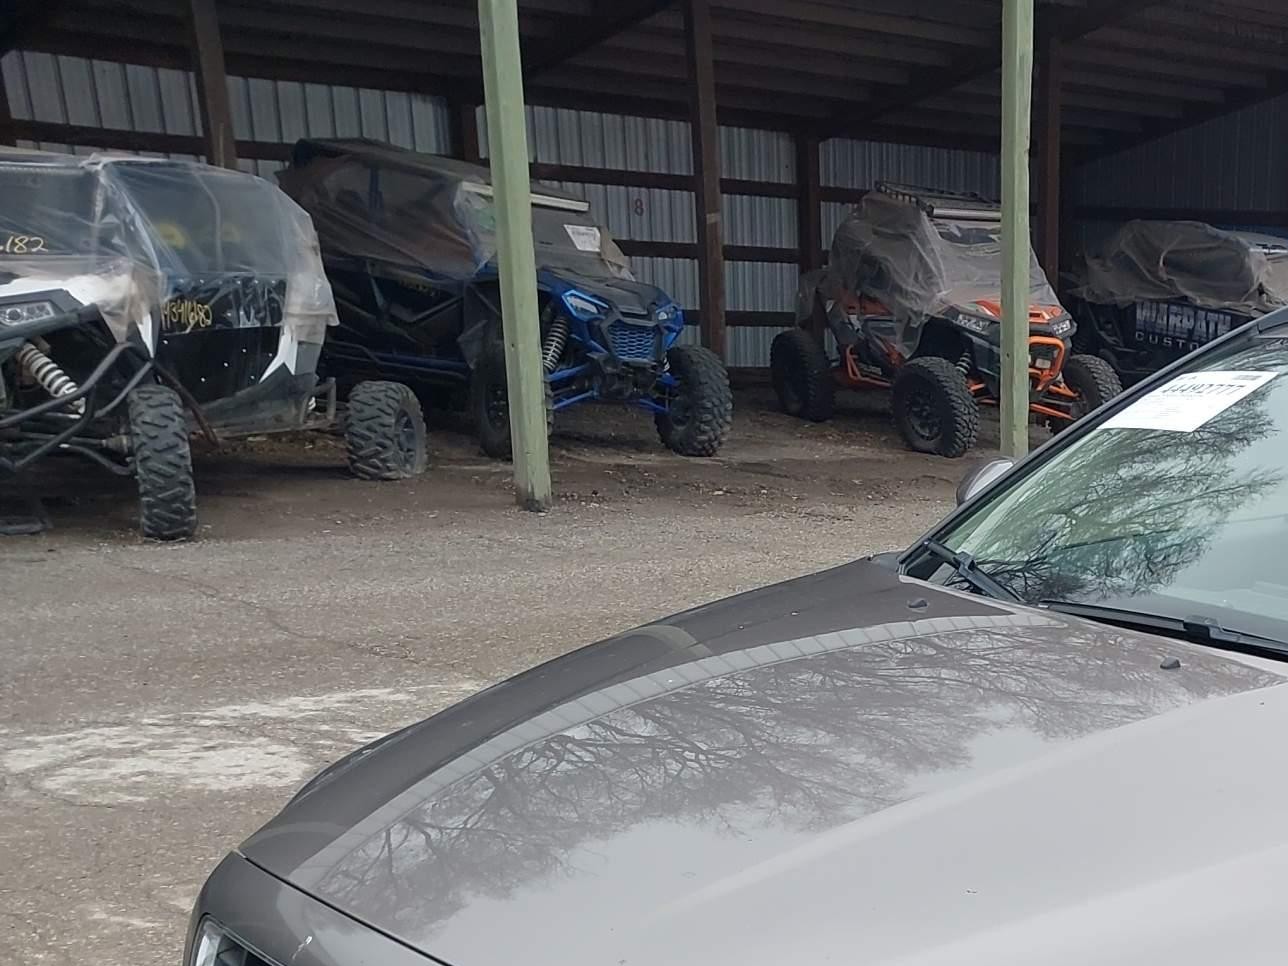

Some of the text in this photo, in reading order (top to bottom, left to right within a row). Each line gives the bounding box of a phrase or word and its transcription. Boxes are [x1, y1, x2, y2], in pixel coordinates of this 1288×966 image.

[634, 199, 644, 217] 8
[0, 235, 49, 254] 182
[1135, 300, 1232, 341] WARPATH
